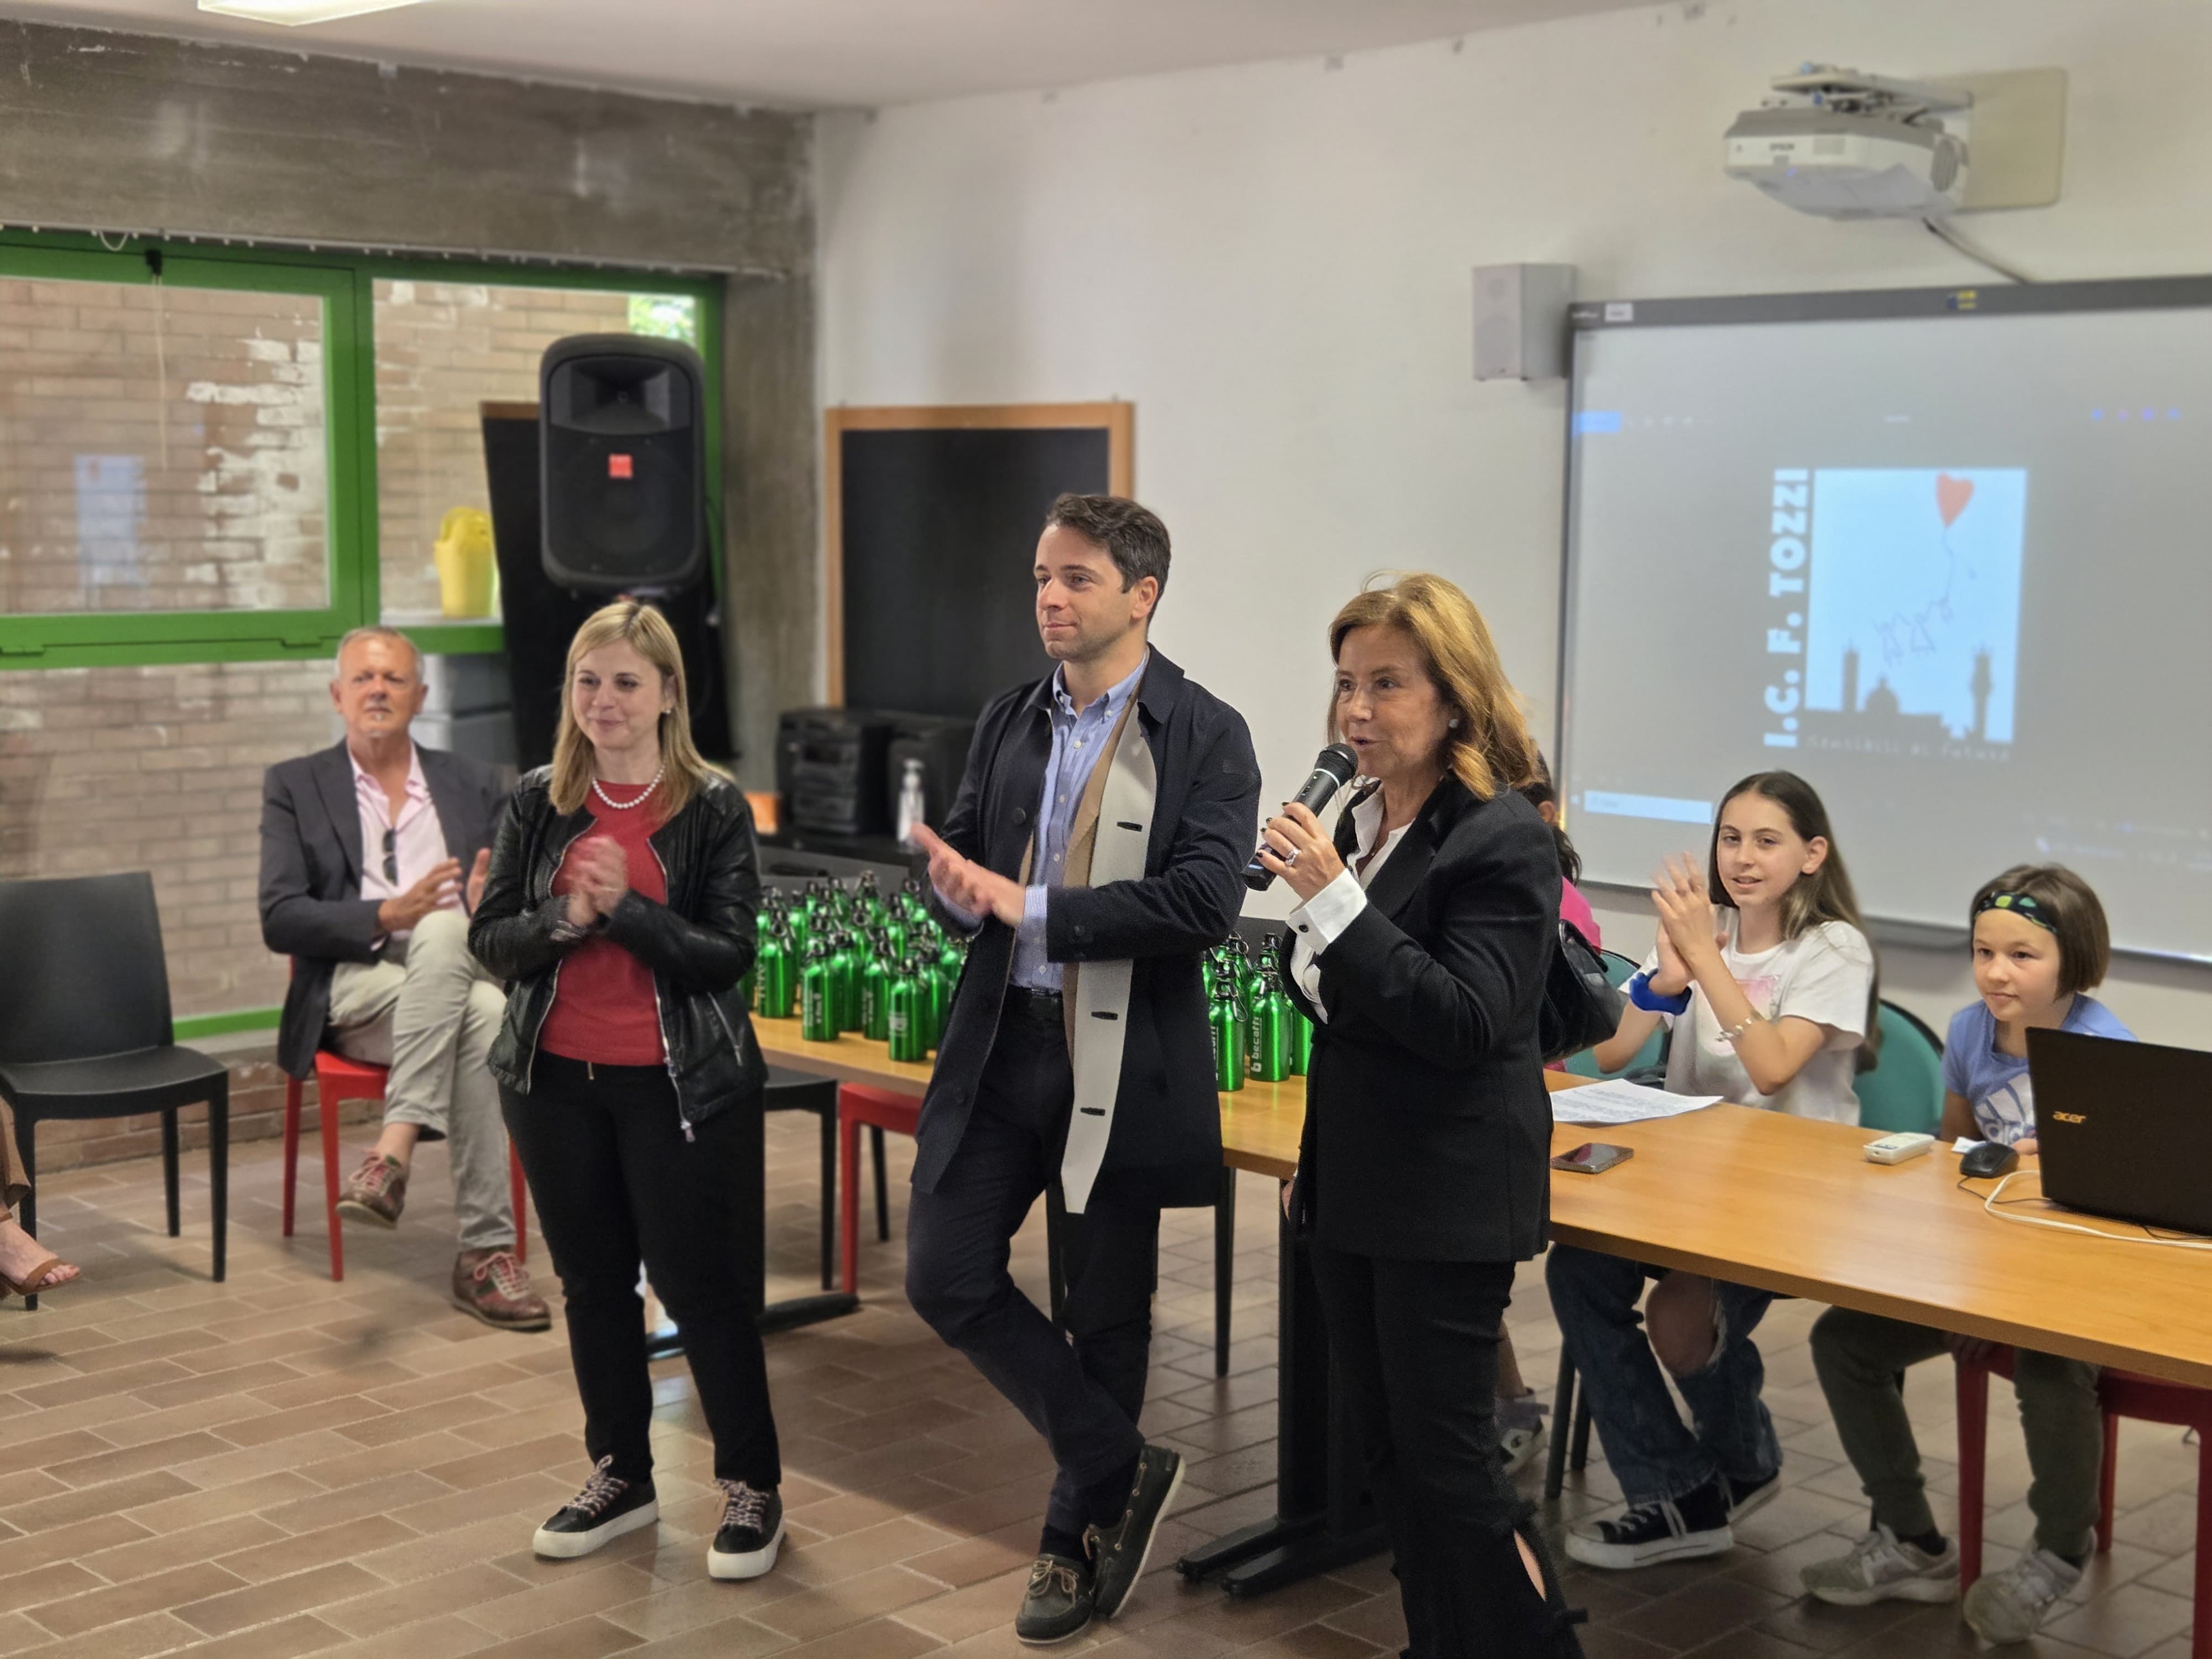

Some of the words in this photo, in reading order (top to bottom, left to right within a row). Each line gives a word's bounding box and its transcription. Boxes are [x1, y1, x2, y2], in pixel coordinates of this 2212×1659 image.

[1770, 468, 1809, 597] TOZZI
[1767, 612, 1803, 654] F.
[1764, 670, 1801, 748] I.C.
[2053, 1111, 2086, 1124] acer
